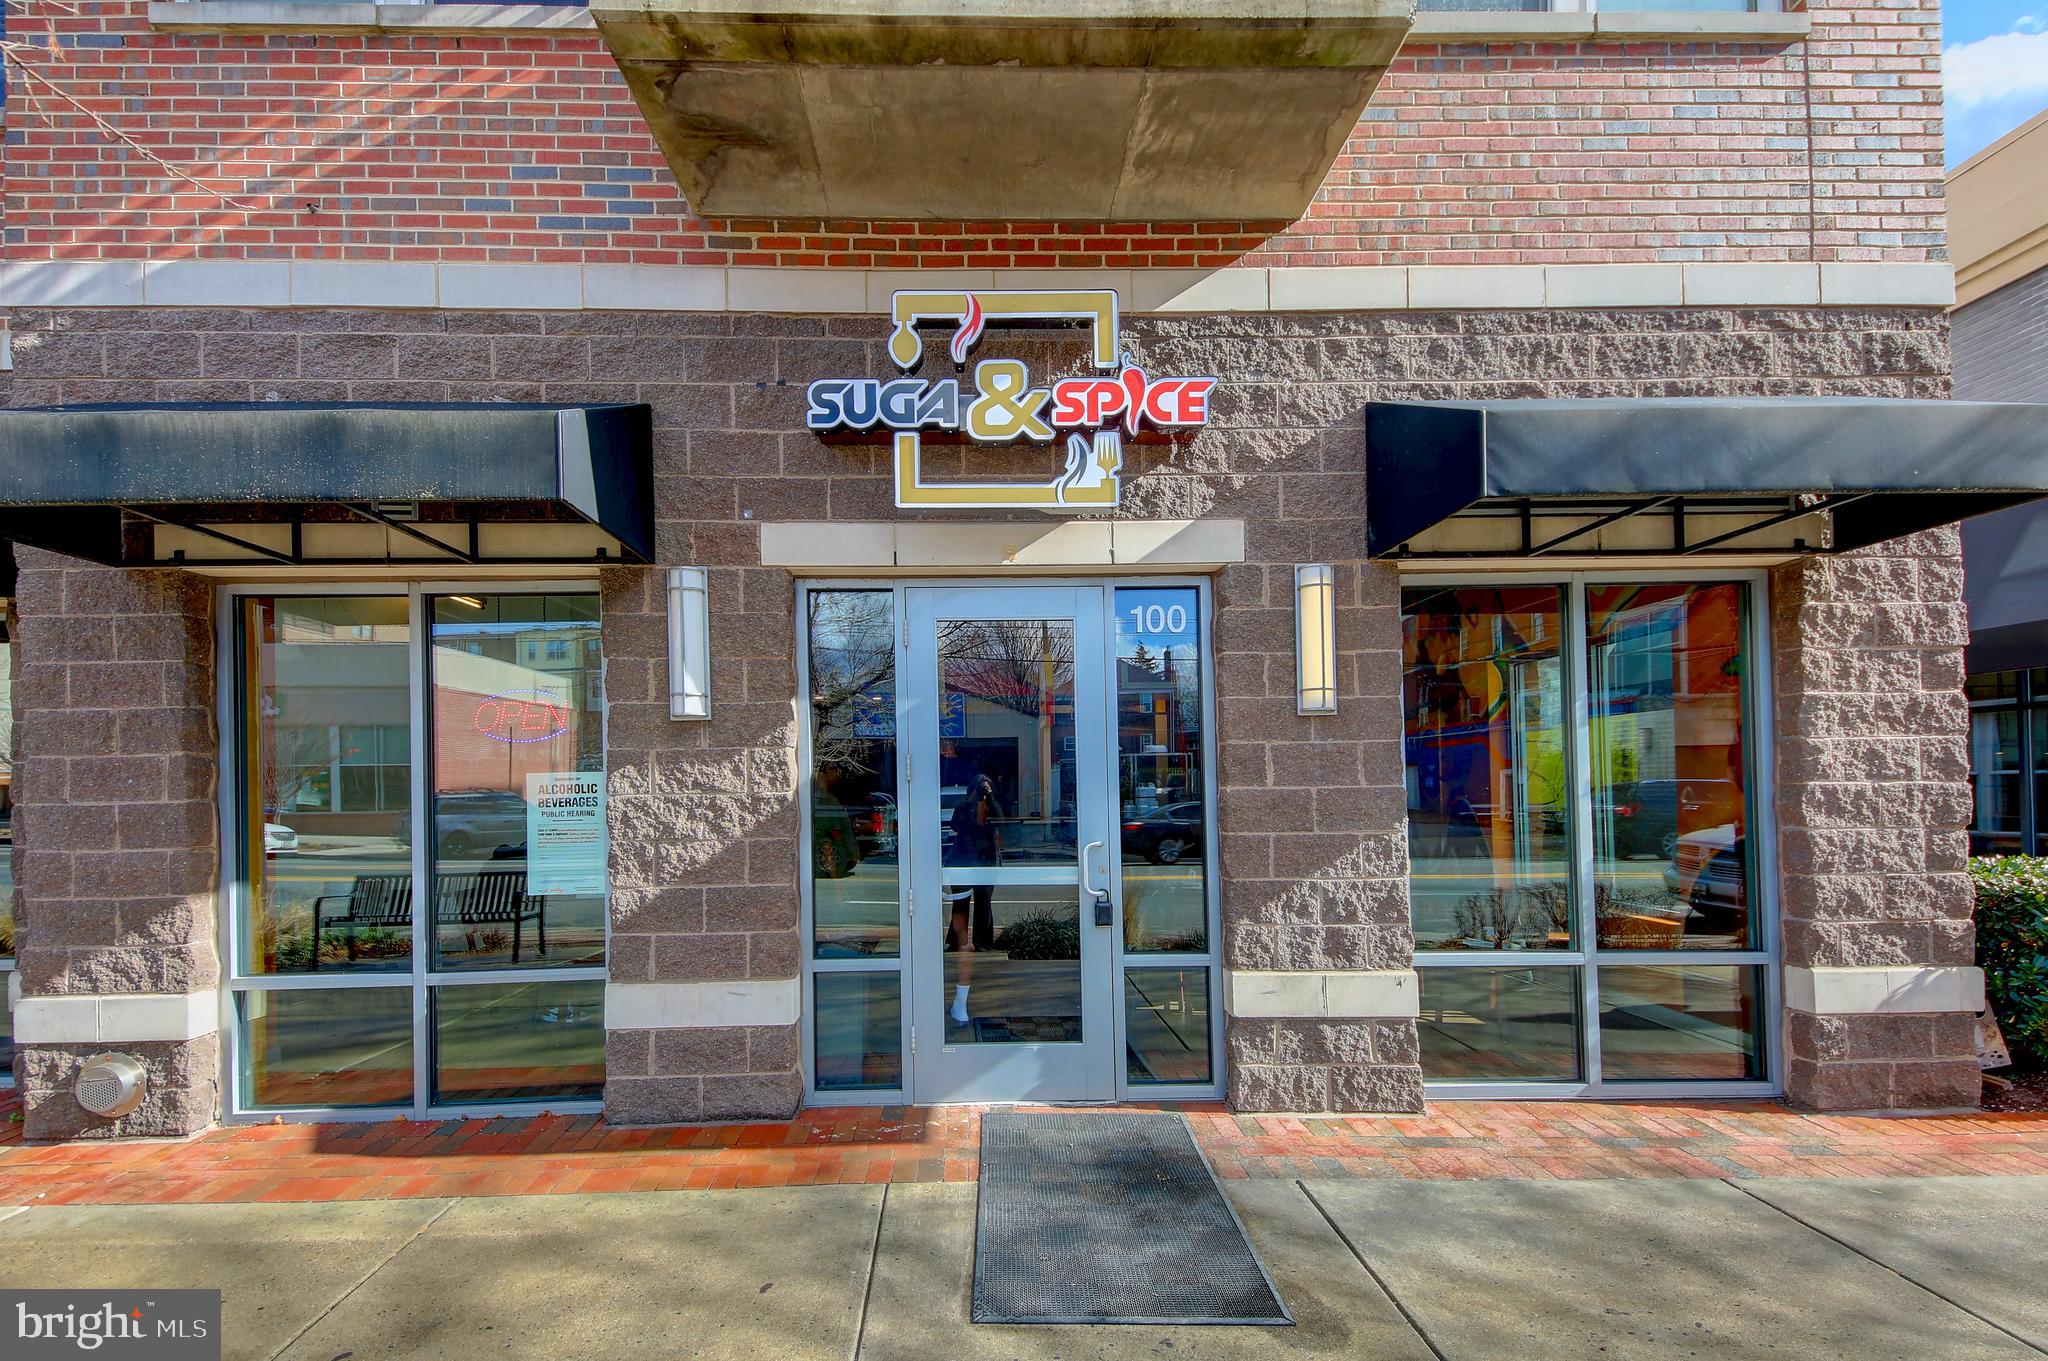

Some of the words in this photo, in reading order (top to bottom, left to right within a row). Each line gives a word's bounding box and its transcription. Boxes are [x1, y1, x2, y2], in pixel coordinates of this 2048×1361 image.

[809, 379, 958, 426] SUGA
[969, 360, 1055, 440] &
[1053, 360, 1218, 434] SPICE
[1130, 605, 1187, 633] 100
[475, 700, 568, 732] OPEN
[538, 783, 598, 795] ALCOHOLIC
[538, 797, 598, 808] BEVERAGES
